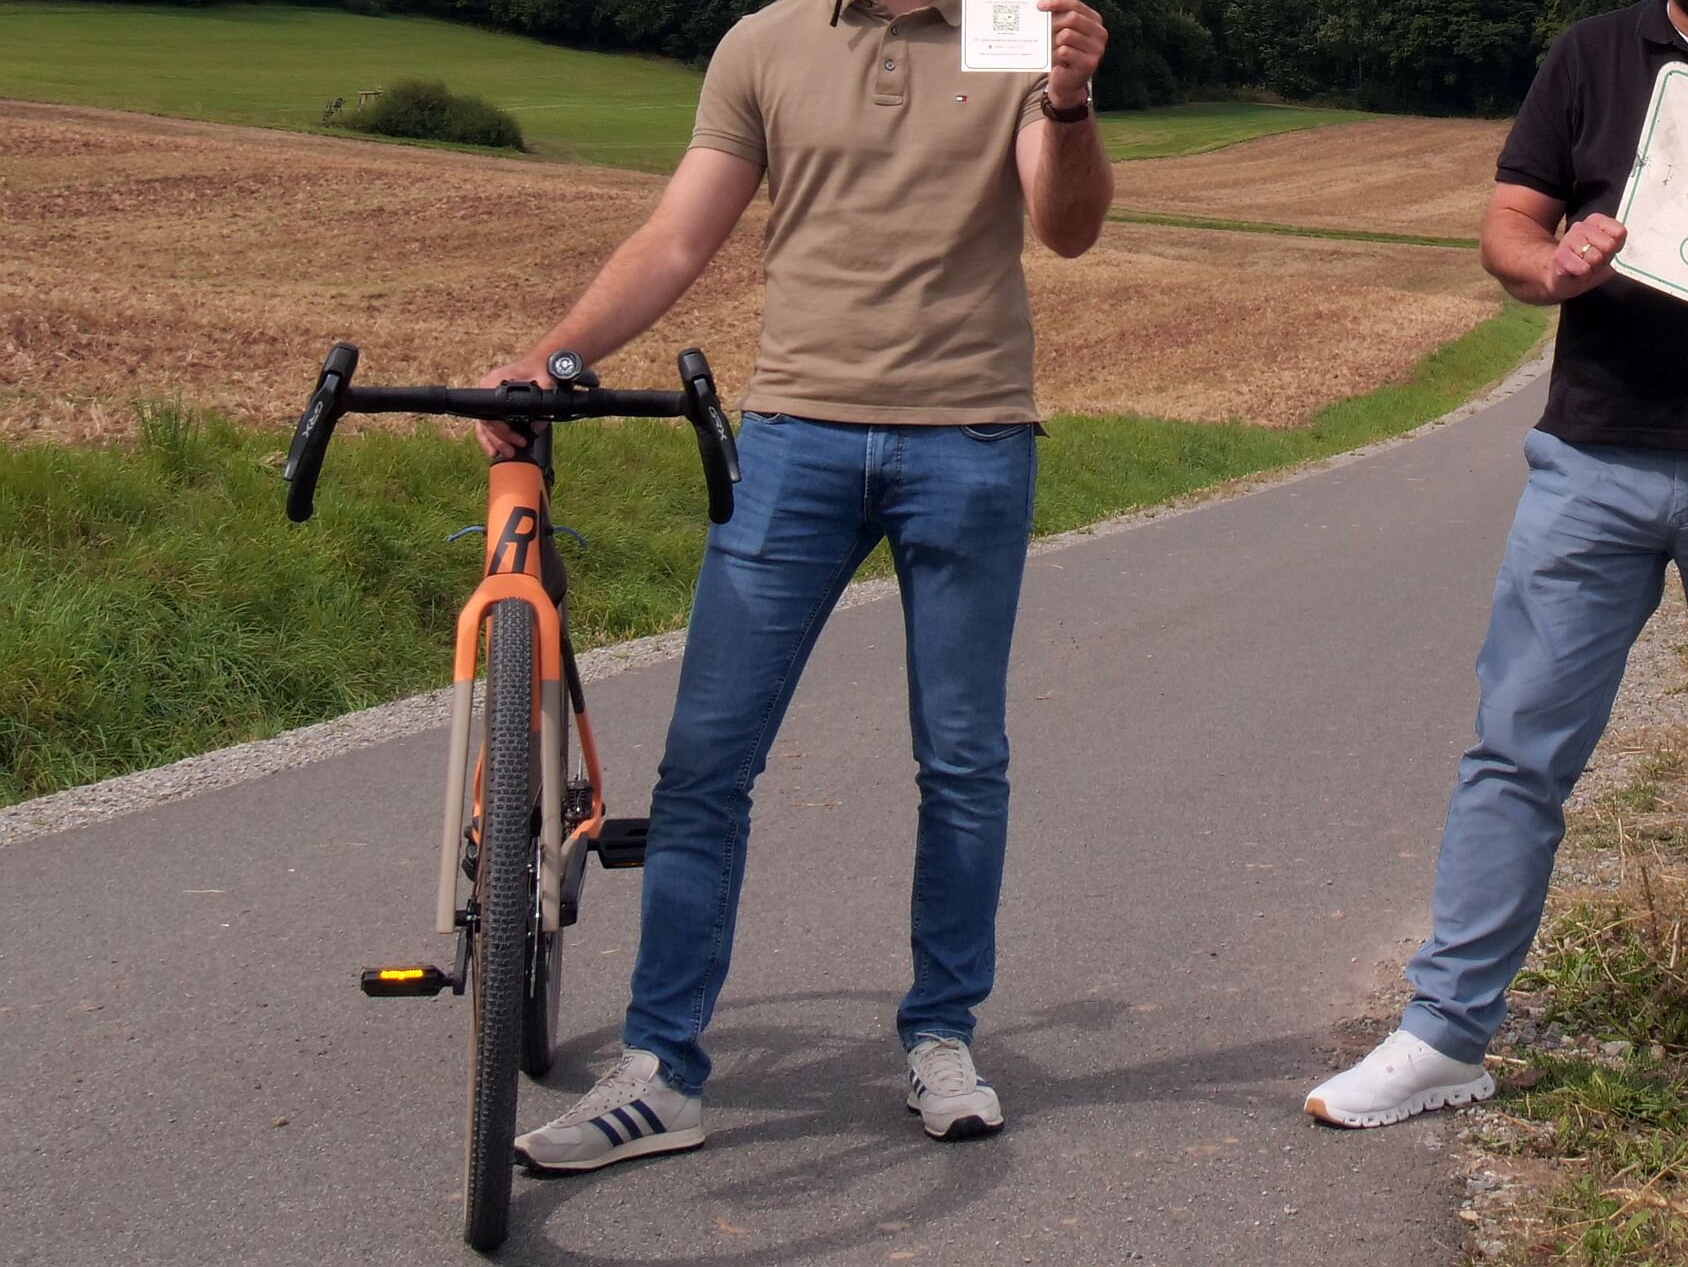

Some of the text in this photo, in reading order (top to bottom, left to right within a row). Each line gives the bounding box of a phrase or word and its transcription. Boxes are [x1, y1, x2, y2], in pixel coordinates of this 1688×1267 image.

[301, 400, 324, 438] GRX
[708, 405, 728, 441] GRX
[487, 505, 538, 577] R
